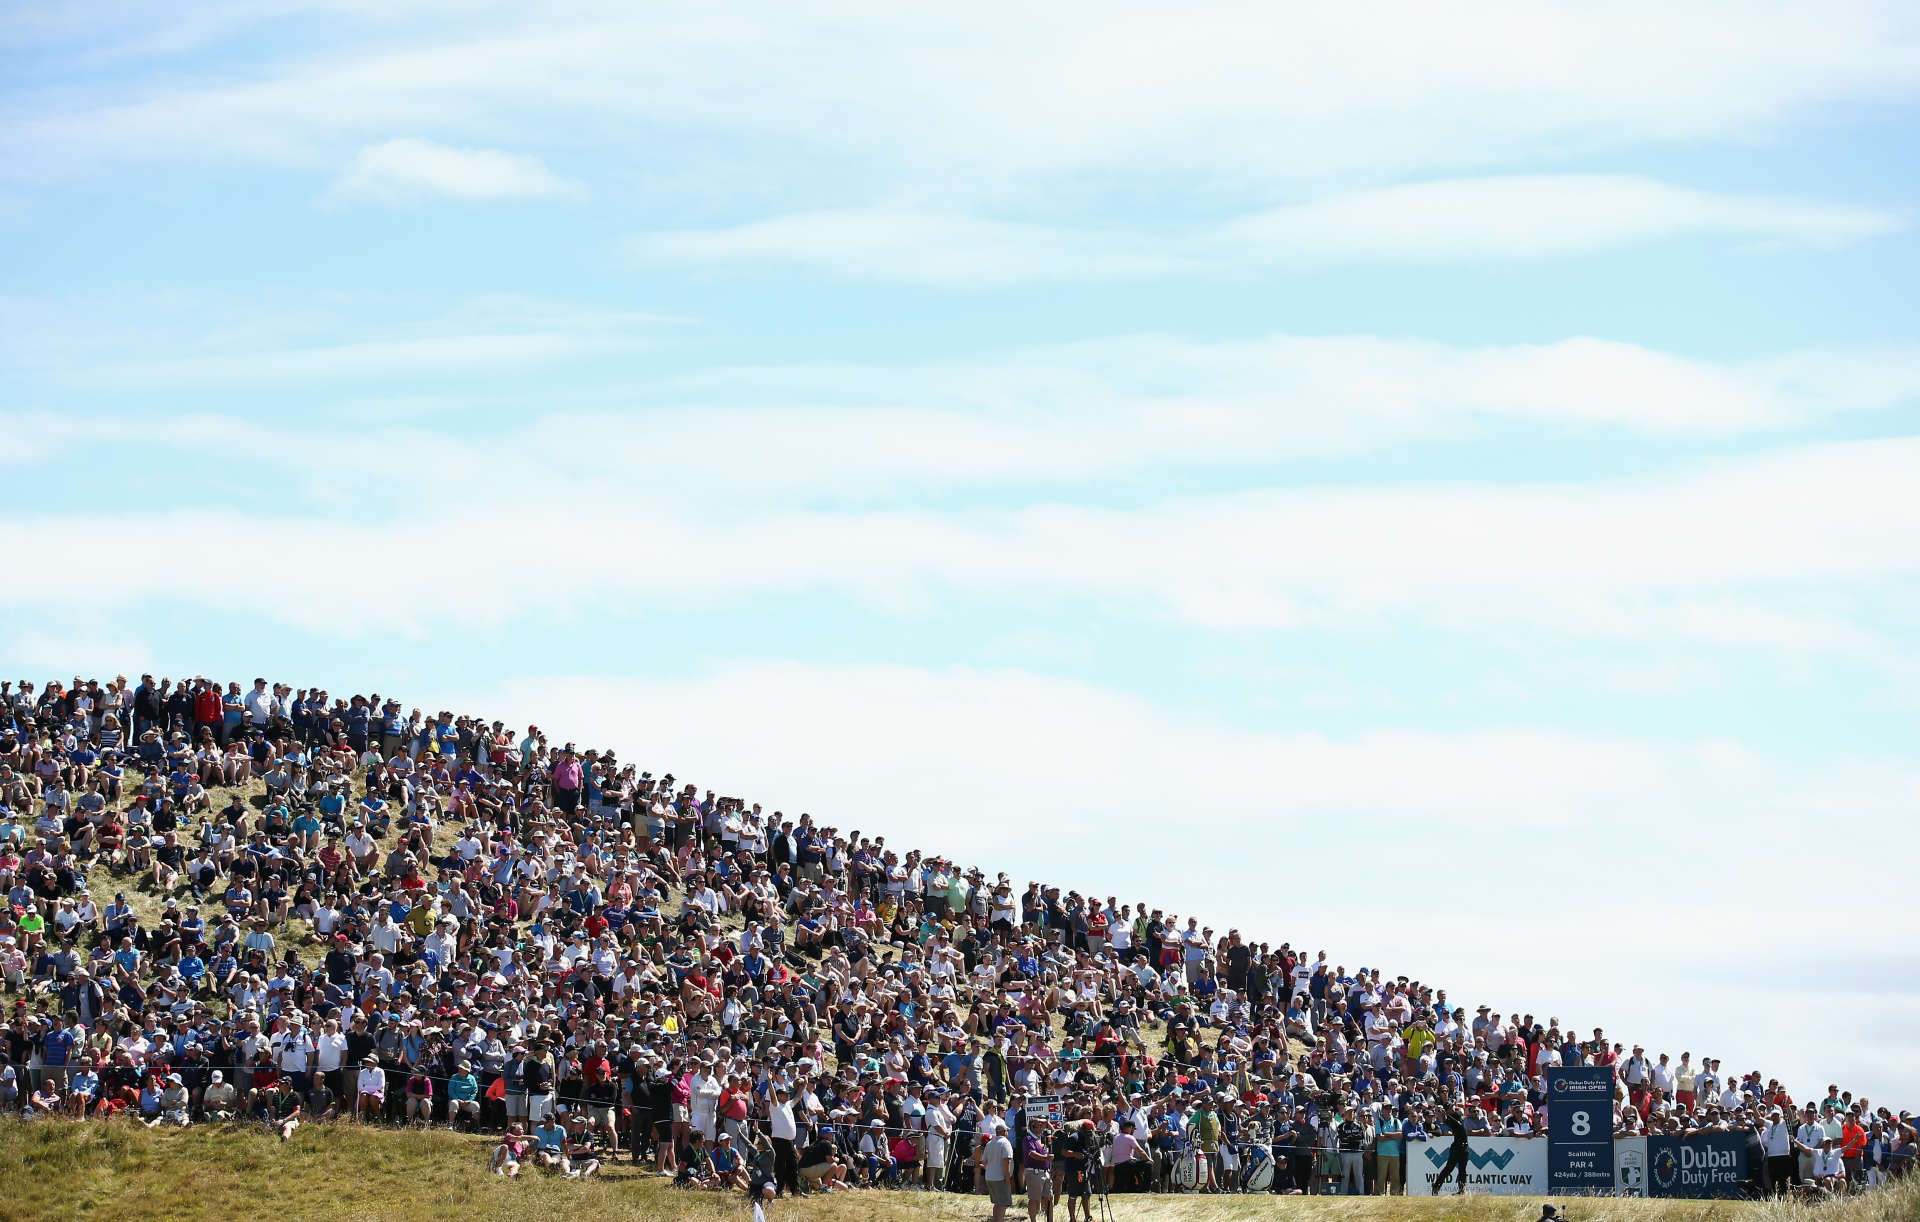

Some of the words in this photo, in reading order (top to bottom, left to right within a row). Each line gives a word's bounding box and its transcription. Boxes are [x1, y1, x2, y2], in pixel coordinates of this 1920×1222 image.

[1571, 1110, 1591, 1136] 8
[1569, 1161, 1586, 1169] PAR
[1588, 1161, 1594, 1169] 4
[1680, 1145, 1737, 1169] Dubai
[1509, 1174, 1533, 1185] WAY
[1681, 1170, 1709, 1188] Duty
[1711, 1169, 1737, 1183] Free
